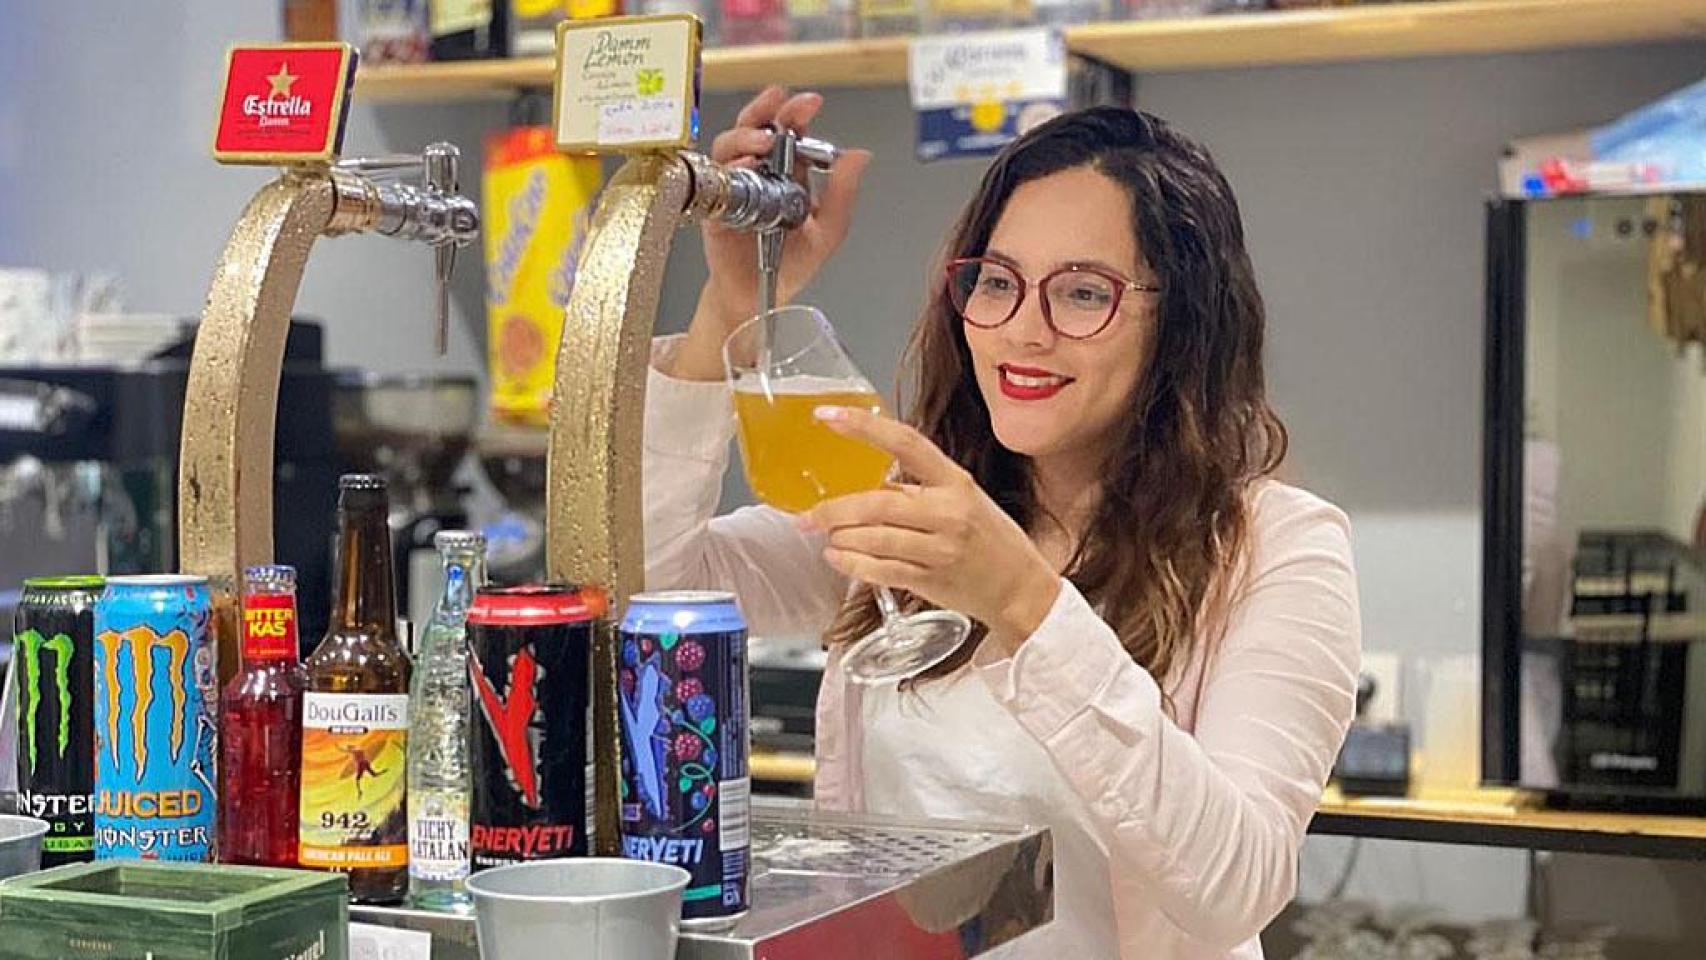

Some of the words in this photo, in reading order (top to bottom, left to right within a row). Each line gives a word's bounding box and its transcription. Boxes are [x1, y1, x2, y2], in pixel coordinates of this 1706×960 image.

[590, 31, 651, 52] Damm
[583, 46, 643, 70] Lemon
[243, 94, 311, 117] Estrella
[250, 621, 286, 637] KAS
[308, 702, 399, 722] DouGall's
[321, 811, 369, 829] 942
[416, 819, 456, 841] VICHY
[472, 826, 574, 857] ENERYETI
